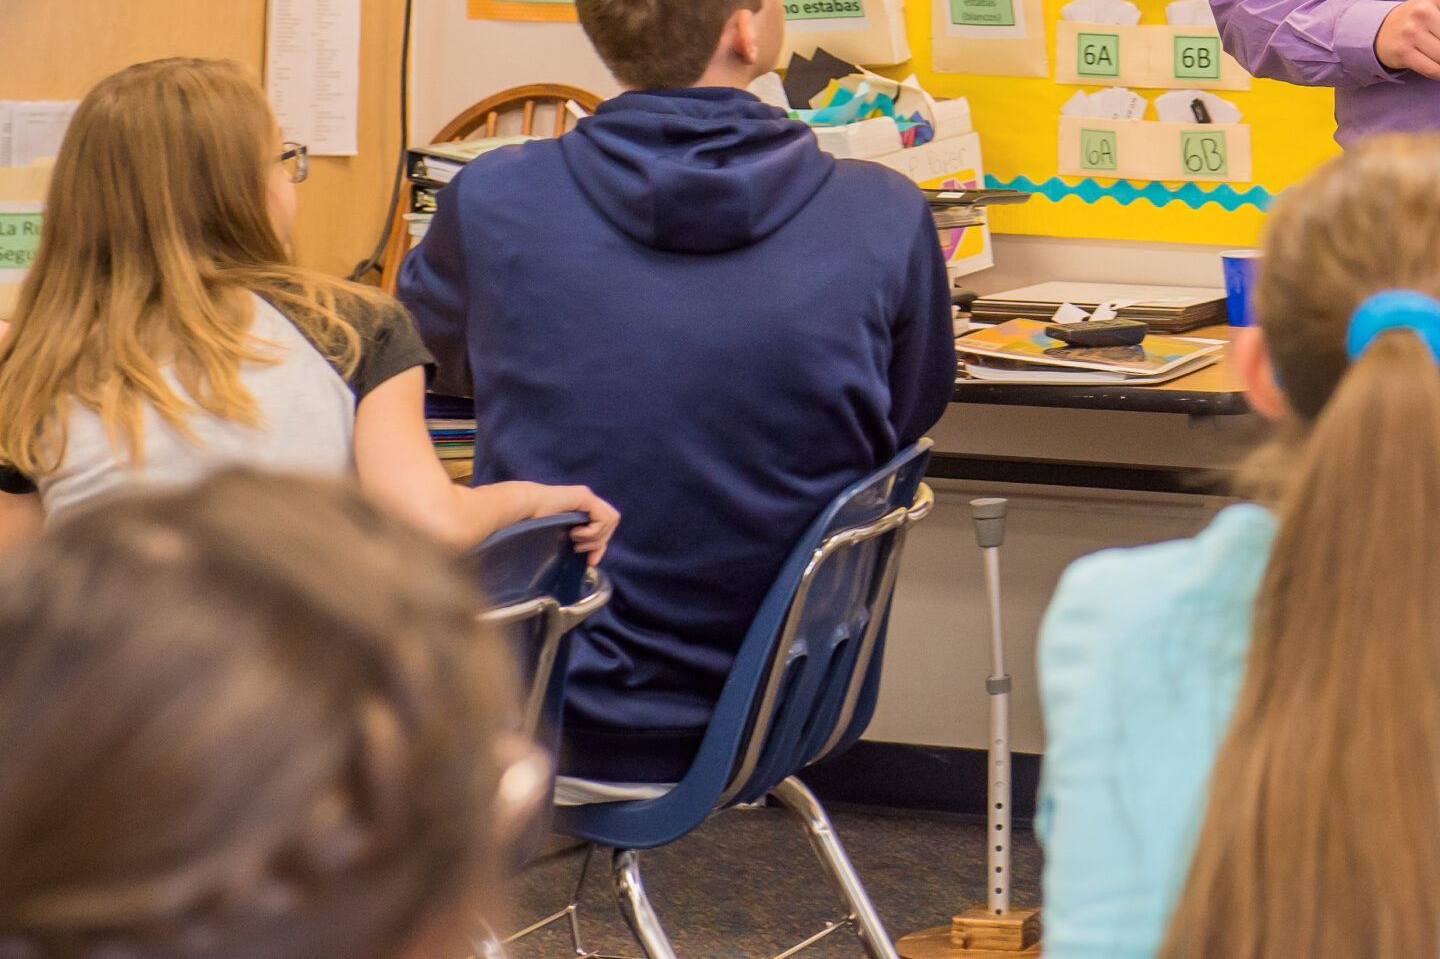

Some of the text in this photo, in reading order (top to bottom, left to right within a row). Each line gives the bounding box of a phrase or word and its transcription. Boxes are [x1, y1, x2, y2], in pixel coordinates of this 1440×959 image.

[1083, 44, 1113, 66] 6A
[1181, 46, 1211, 69] 6B
[1086, 138, 1113, 166] 6A
[1183, 137, 1224, 172] 6B
